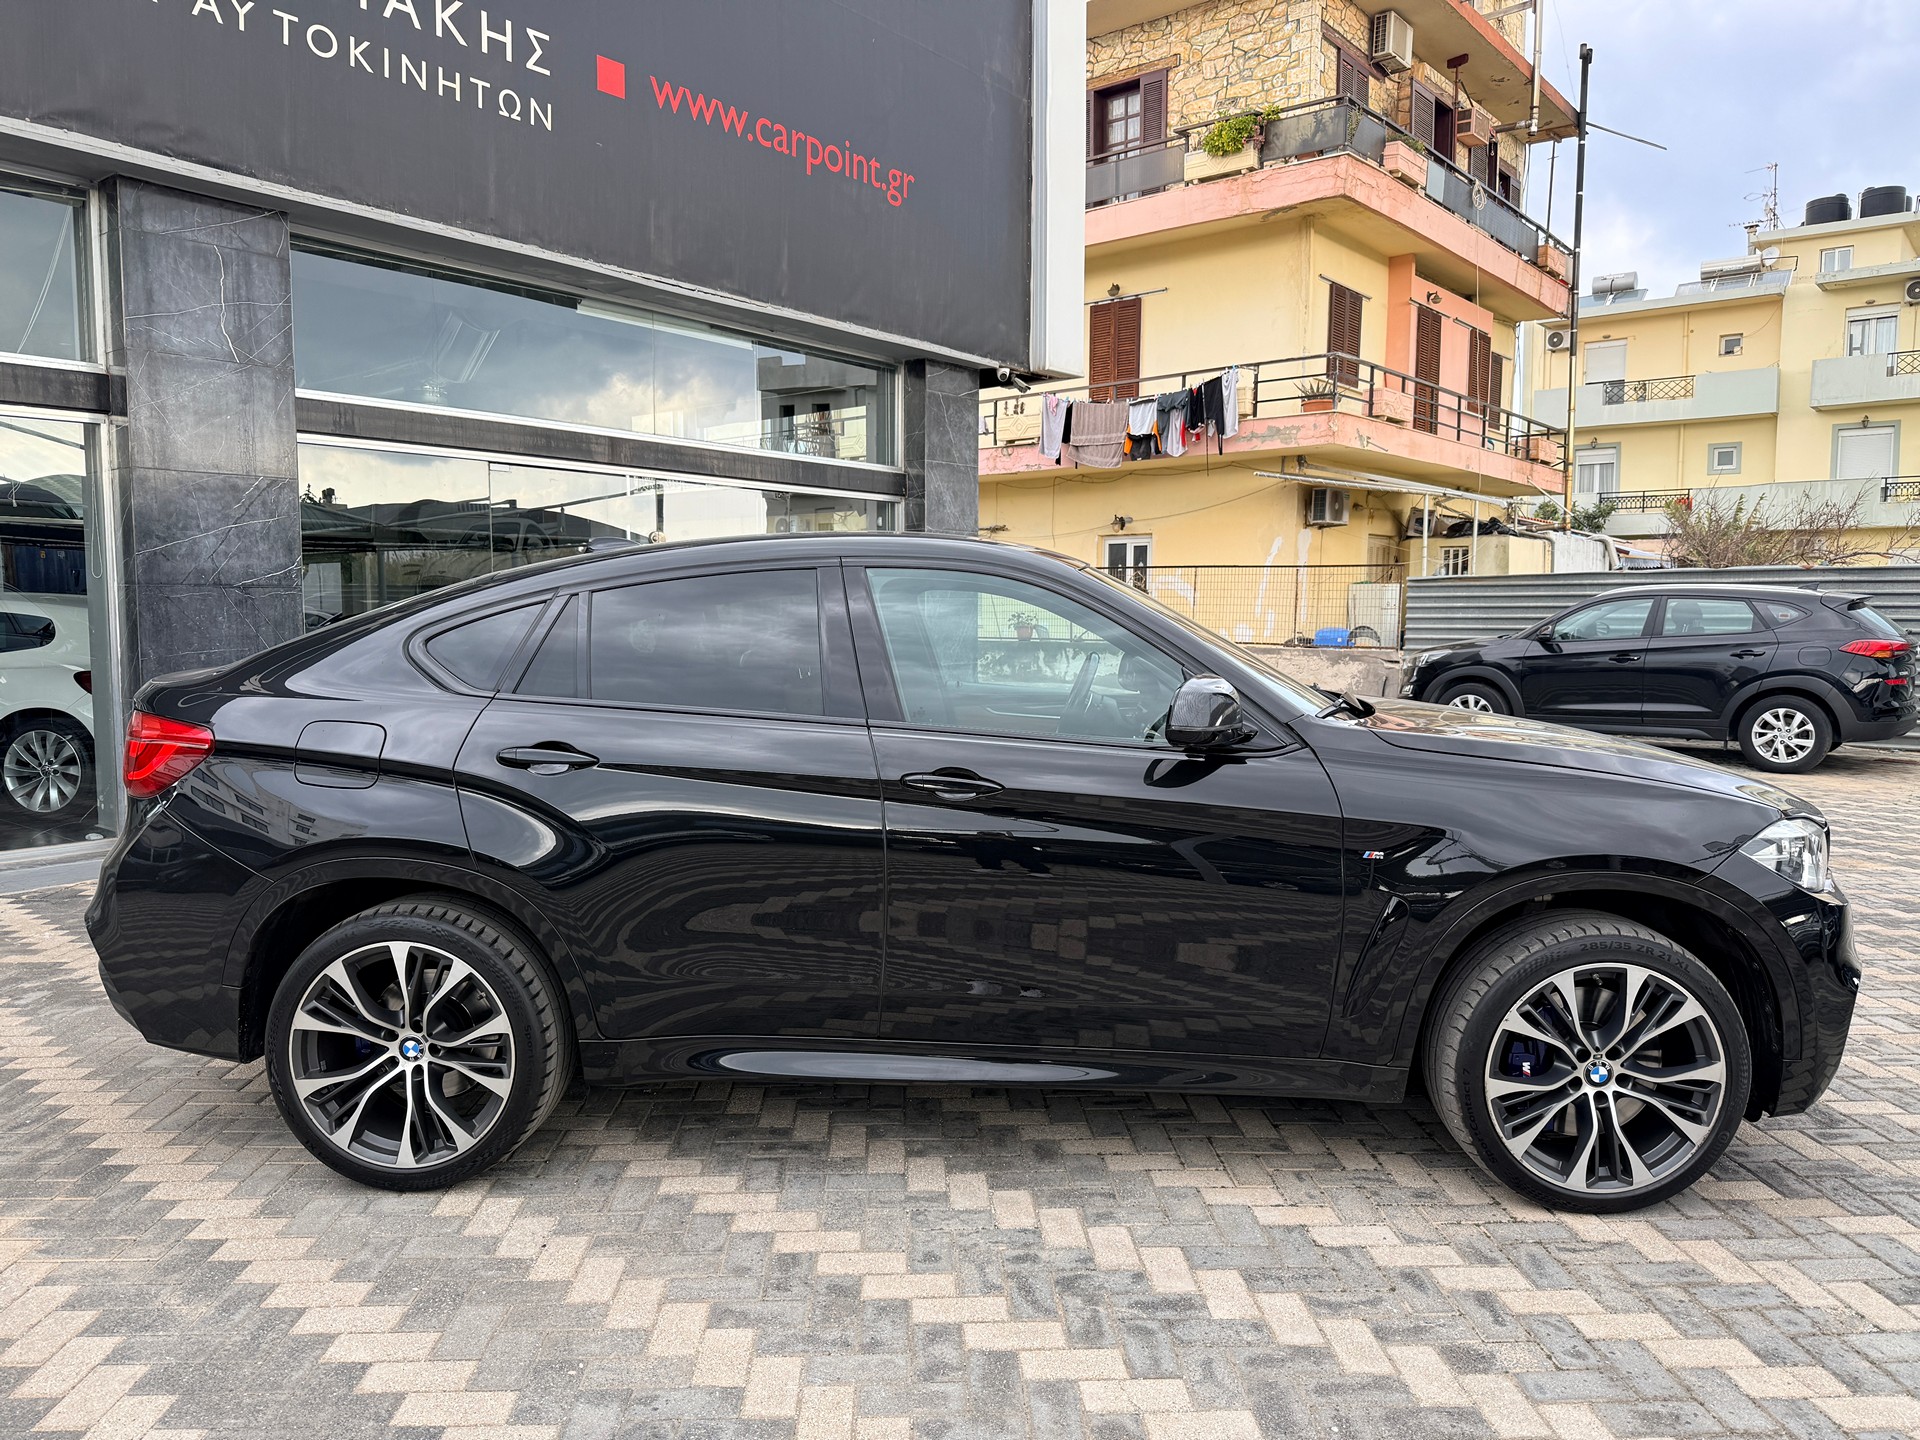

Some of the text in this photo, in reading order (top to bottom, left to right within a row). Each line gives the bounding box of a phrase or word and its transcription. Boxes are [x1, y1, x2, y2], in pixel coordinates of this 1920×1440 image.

[359, 0, 551, 77] ΑΚΗΣ
[649, 75, 915, 207] www.carpoint.gr
[1580, 941, 1691, 974] 285/35 ZR 21 XL
